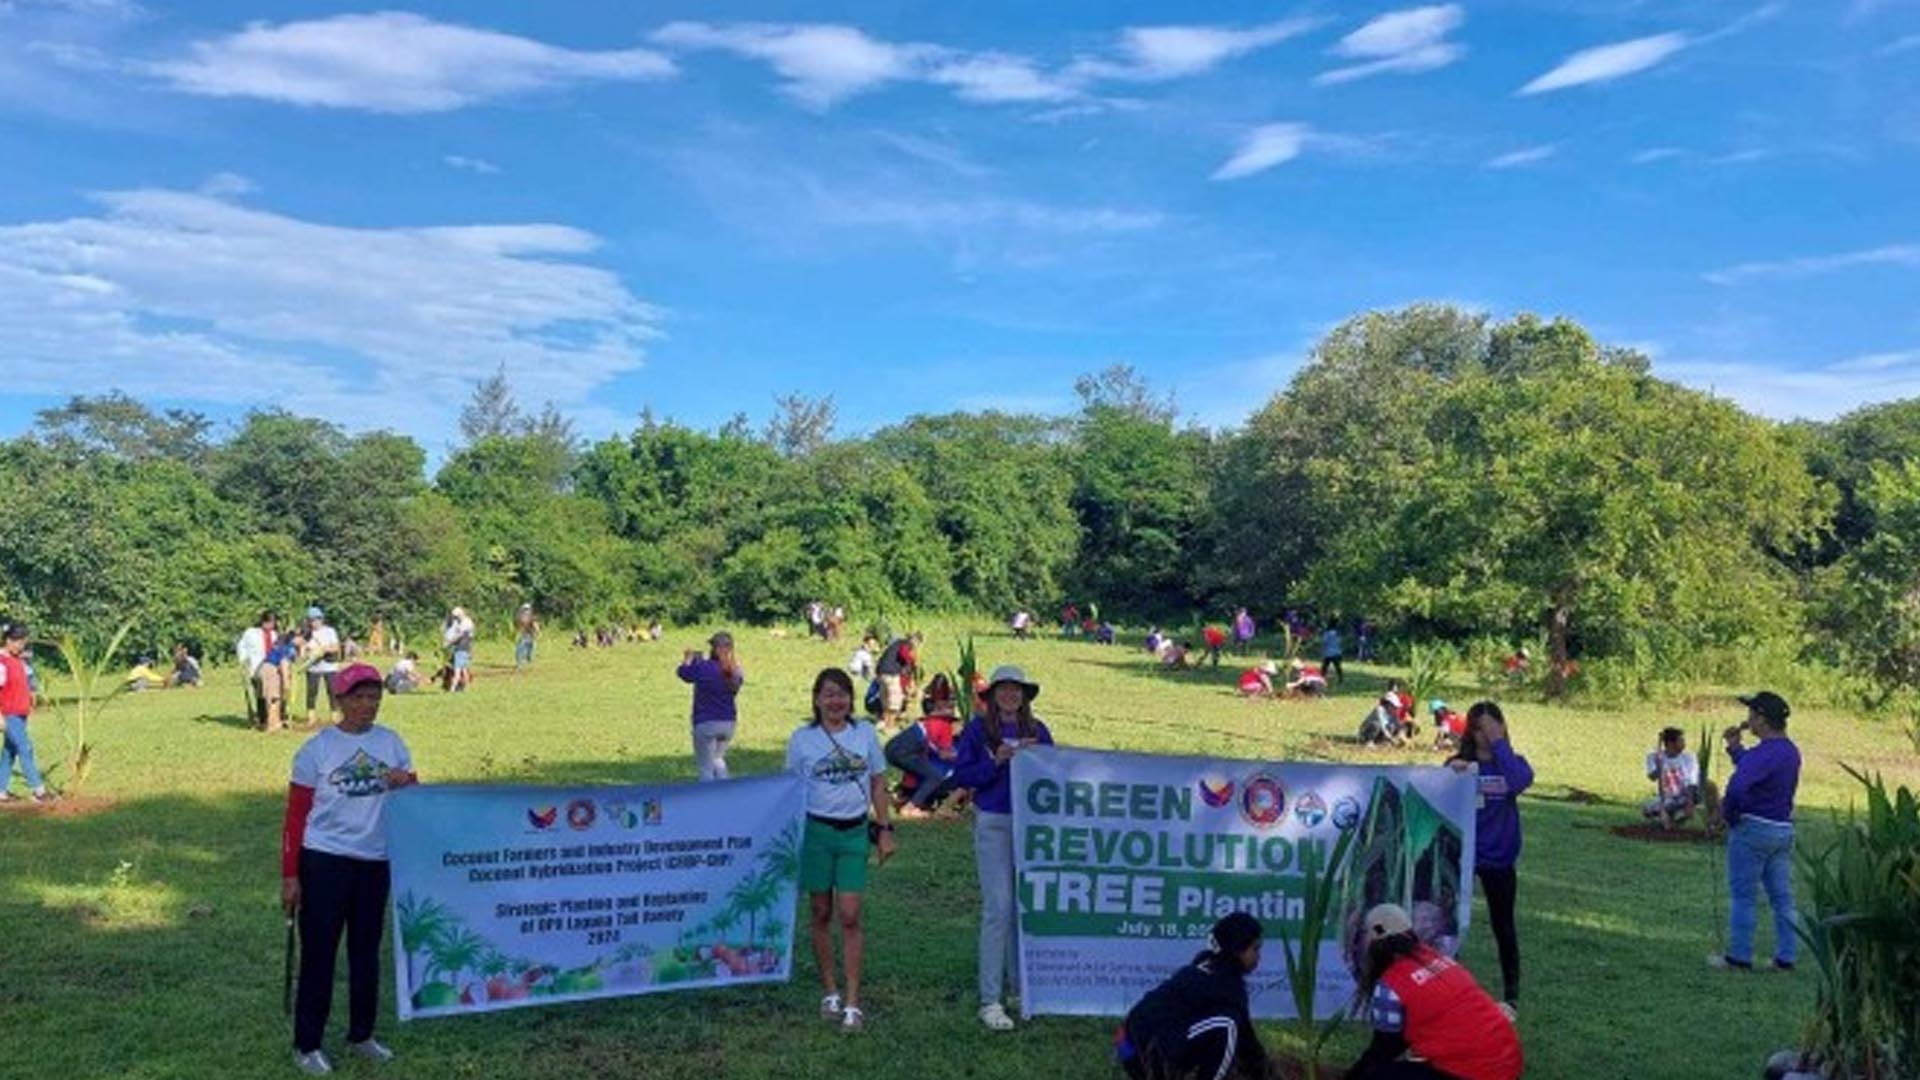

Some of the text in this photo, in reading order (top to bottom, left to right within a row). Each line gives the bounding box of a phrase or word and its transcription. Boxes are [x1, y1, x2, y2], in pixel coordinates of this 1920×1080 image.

[1027, 778, 1191, 820] GREEN
[443, 836, 752, 867] Coconut Farmers and Industry Development Plan
[1024, 825, 1325, 872] REVOLUTION
[469, 866, 525, 882] Coconut
[529, 860, 612, 879] Hybridization
[616, 858, 662, 873] Project
[496, 902, 556, 918] Strategic
[560, 897, 612, 913] Planting
[616, 895, 639, 909] and
[1023, 871, 1306, 921] TREE Plantin
[521, 919, 533, 934] of
[567, 914, 612, 931] Laguna
[617, 911, 638, 926] Tall
[643, 909, 685, 924] Variety
[1117, 921, 1150, 936] July
[1158, 922, 1182, 938] 18,
